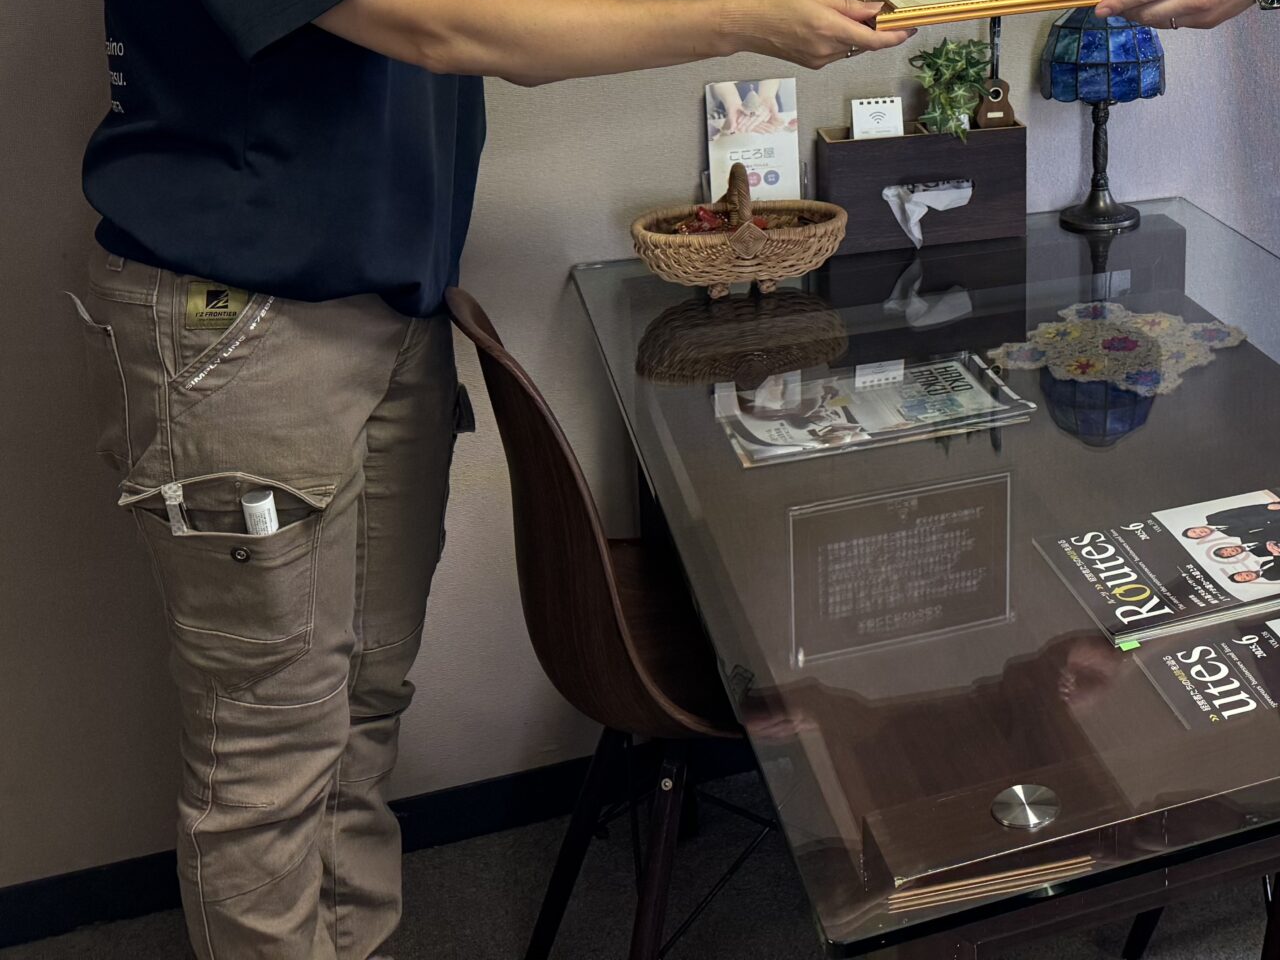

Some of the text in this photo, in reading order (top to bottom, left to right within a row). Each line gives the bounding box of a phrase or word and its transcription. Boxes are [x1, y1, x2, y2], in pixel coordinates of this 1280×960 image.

[933, 365, 974, 392] HAKO
[1070, 531, 1175, 625] Routes
[1176, 645, 1258, 720] utes
